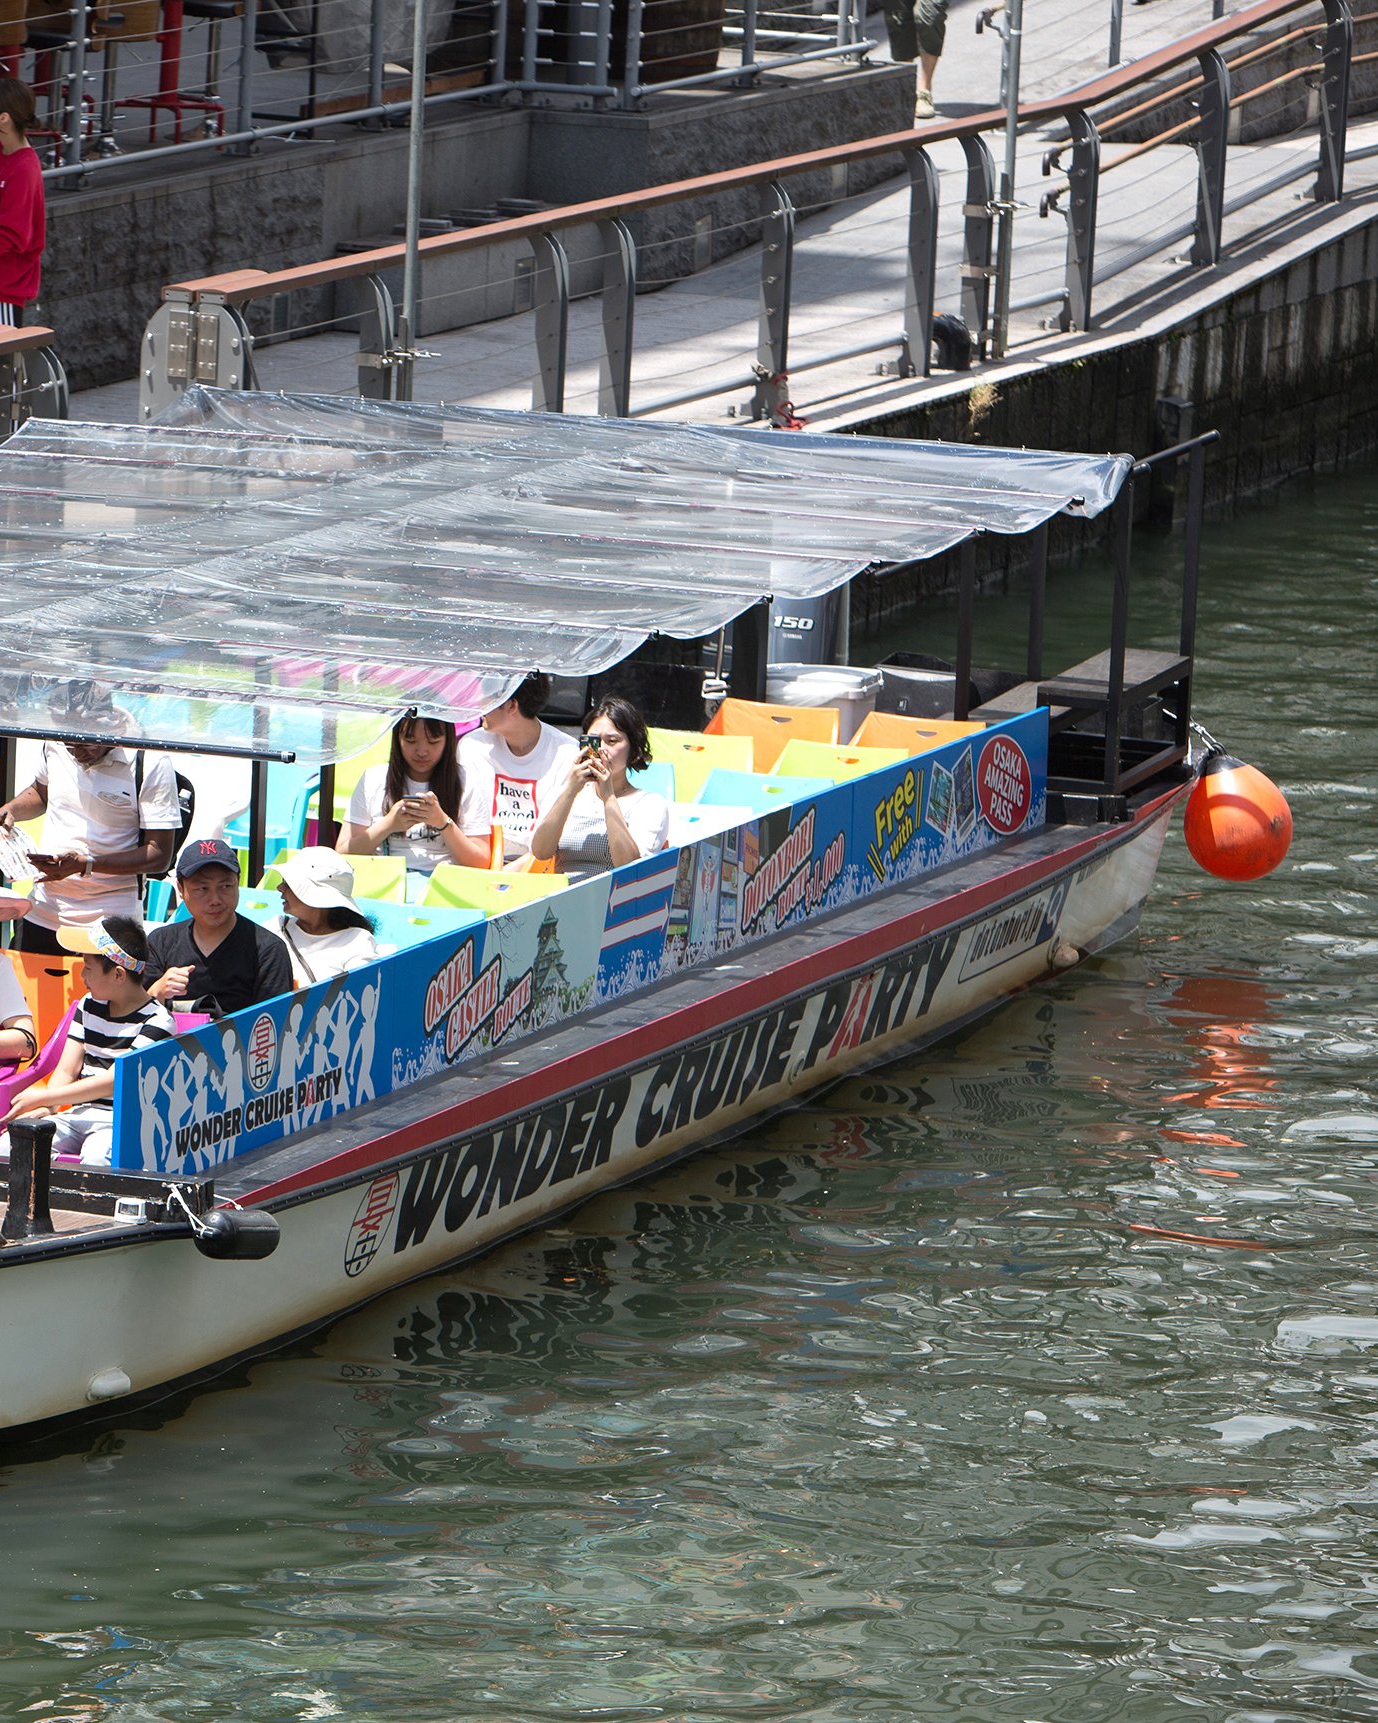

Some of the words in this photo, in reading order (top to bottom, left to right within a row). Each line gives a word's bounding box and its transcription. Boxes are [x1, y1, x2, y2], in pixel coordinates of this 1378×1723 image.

[773, 616, 814, 630] 150
[984, 763, 1024, 808] AMAZING
[993, 742, 1022, 781] OSAKA
[500, 782, 530, 800] have
[512, 800, 520, 810] a
[875, 769, 915, 850] Free
[990, 792, 1013, 826] PASS
[199, 840, 217, 854] NY
[889, 814, 913, 861] with
[743, 807, 815, 931] DOTONBORI
[776, 861, 811, 927] ROUTE
[424, 938, 473, 1034] OSAKA
[446, 957, 501, 1061] CASTLE
[493, 970, 532, 1044] ROUTE
[175, 1106, 242, 1158] WONDER
[245, 1086, 295, 1131] CRUISE
[296, 1067, 342, 1110] PARTY
[394, 1077, 632, 1254] WONDER
[635, 1001, 808, 1149] CRUISE
[802, 925, 961, 1071] PARTY
